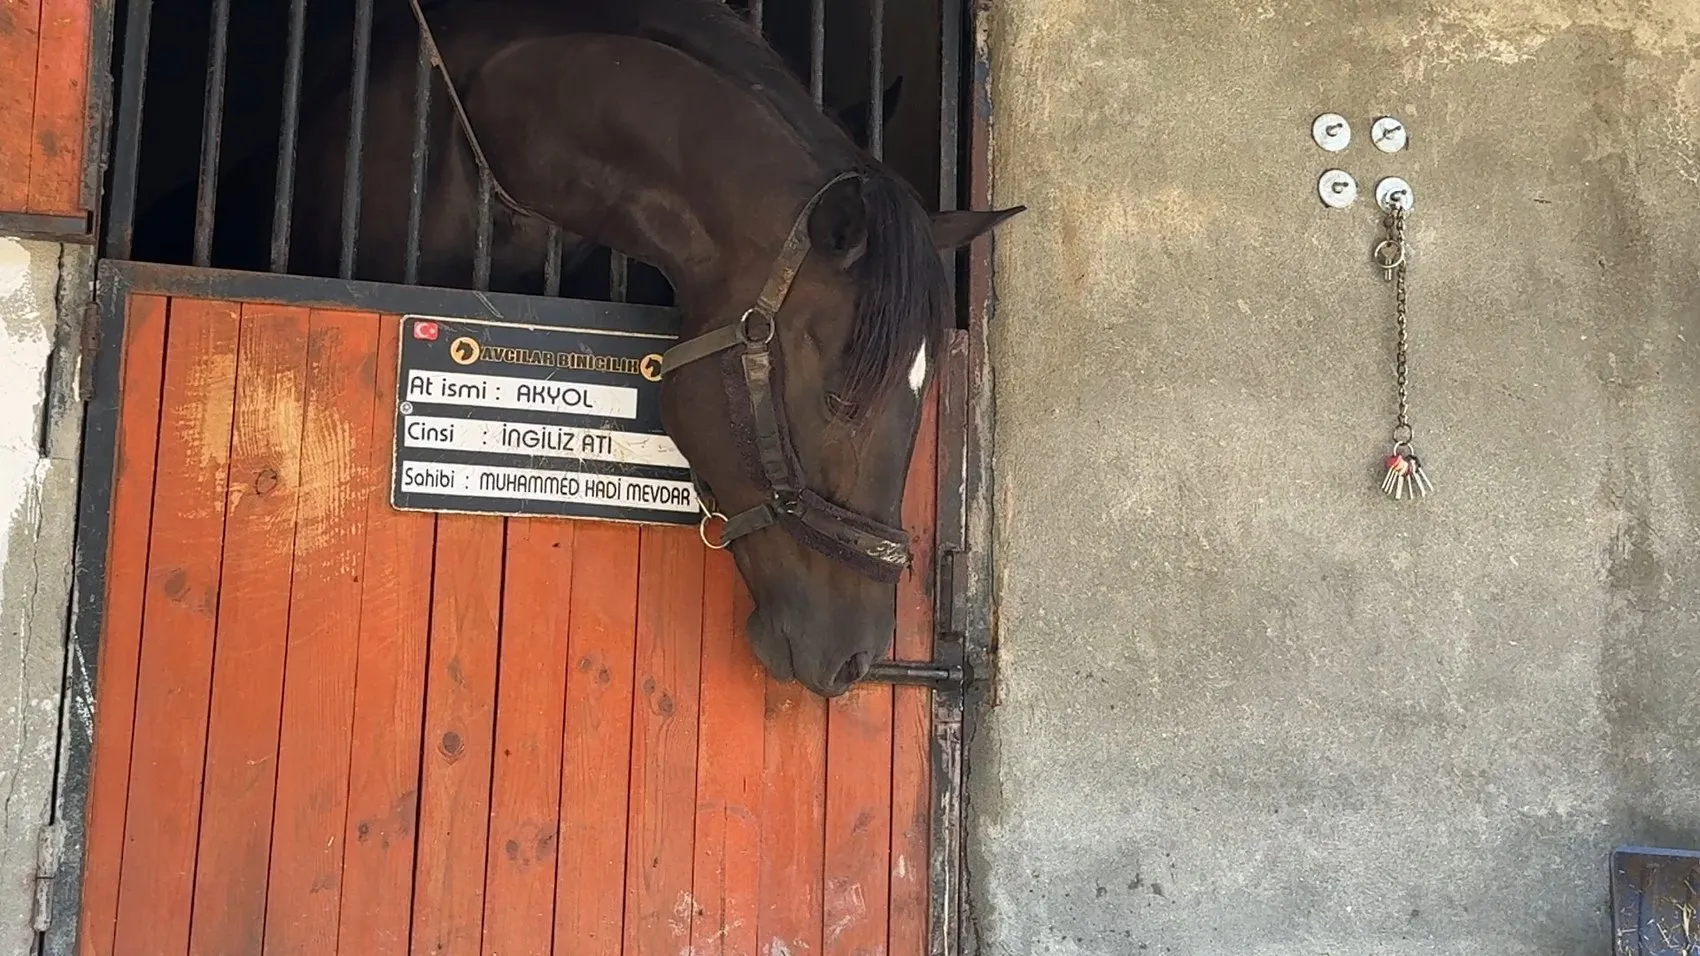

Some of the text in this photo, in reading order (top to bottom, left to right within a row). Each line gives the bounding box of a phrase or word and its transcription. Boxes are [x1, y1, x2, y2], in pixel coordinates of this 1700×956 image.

[480, 346, 556, 367] AVCILAR
[410, 376, 433, 396] At
[441, 378, 487, 400] ismi
[517, 384, 593, 409] AKYOL
[407, 422, 454, 442] Cinsi
[582, 434, 612, 455] ATI
[404, 467, 454, 488] Sahibi
[480, 472, 580, 497] MUHAMMED
[585, 478, 622, 500] HADİ
[626, 483, 690, 507] MEVDAR
